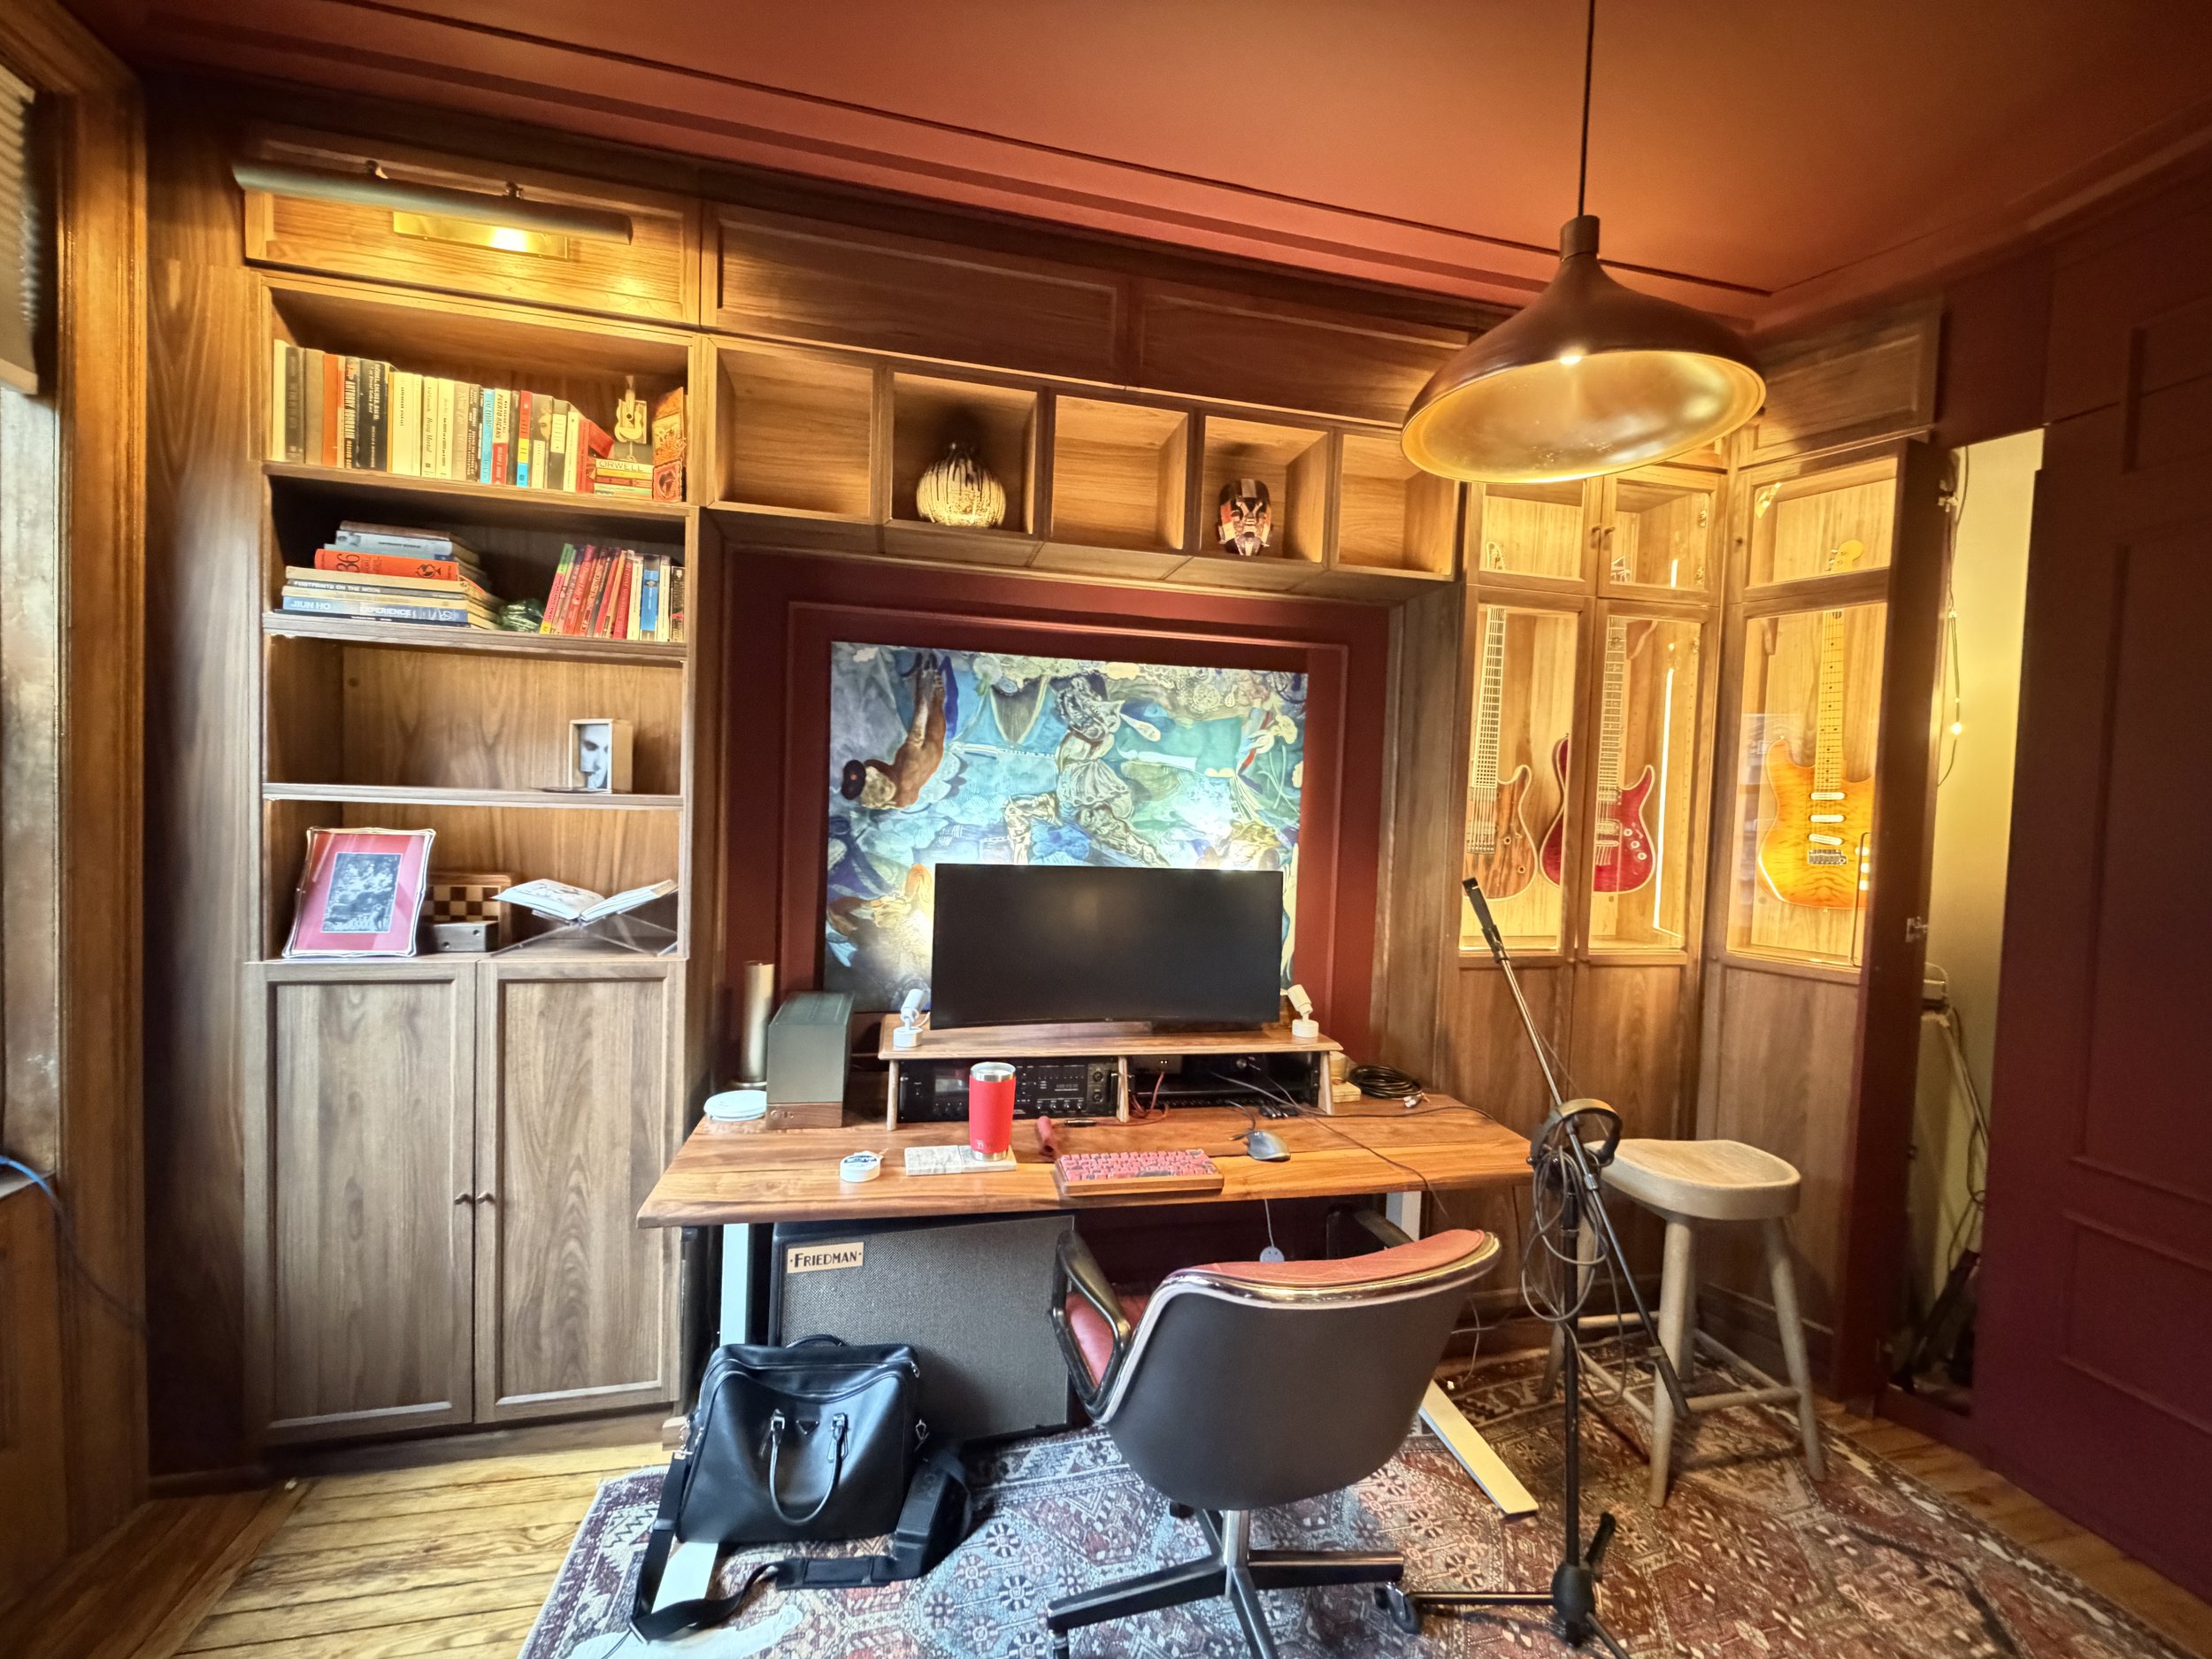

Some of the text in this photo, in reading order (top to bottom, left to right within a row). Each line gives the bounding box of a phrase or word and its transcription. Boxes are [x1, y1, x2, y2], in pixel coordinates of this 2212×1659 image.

[344, 380, 356, 440] ANTHONY BOURDAIN
[598, 460, 643, 472] ORWELL
[336, 553, 360, 573] 36
[294, 580, 334, 590] FOOTPRINTS
[290, 600, 315, 609] JIUN
[359, 606, 411, 617] EXPERIENCE
[794, 1251, 857, 1268] FRIEDMAN
